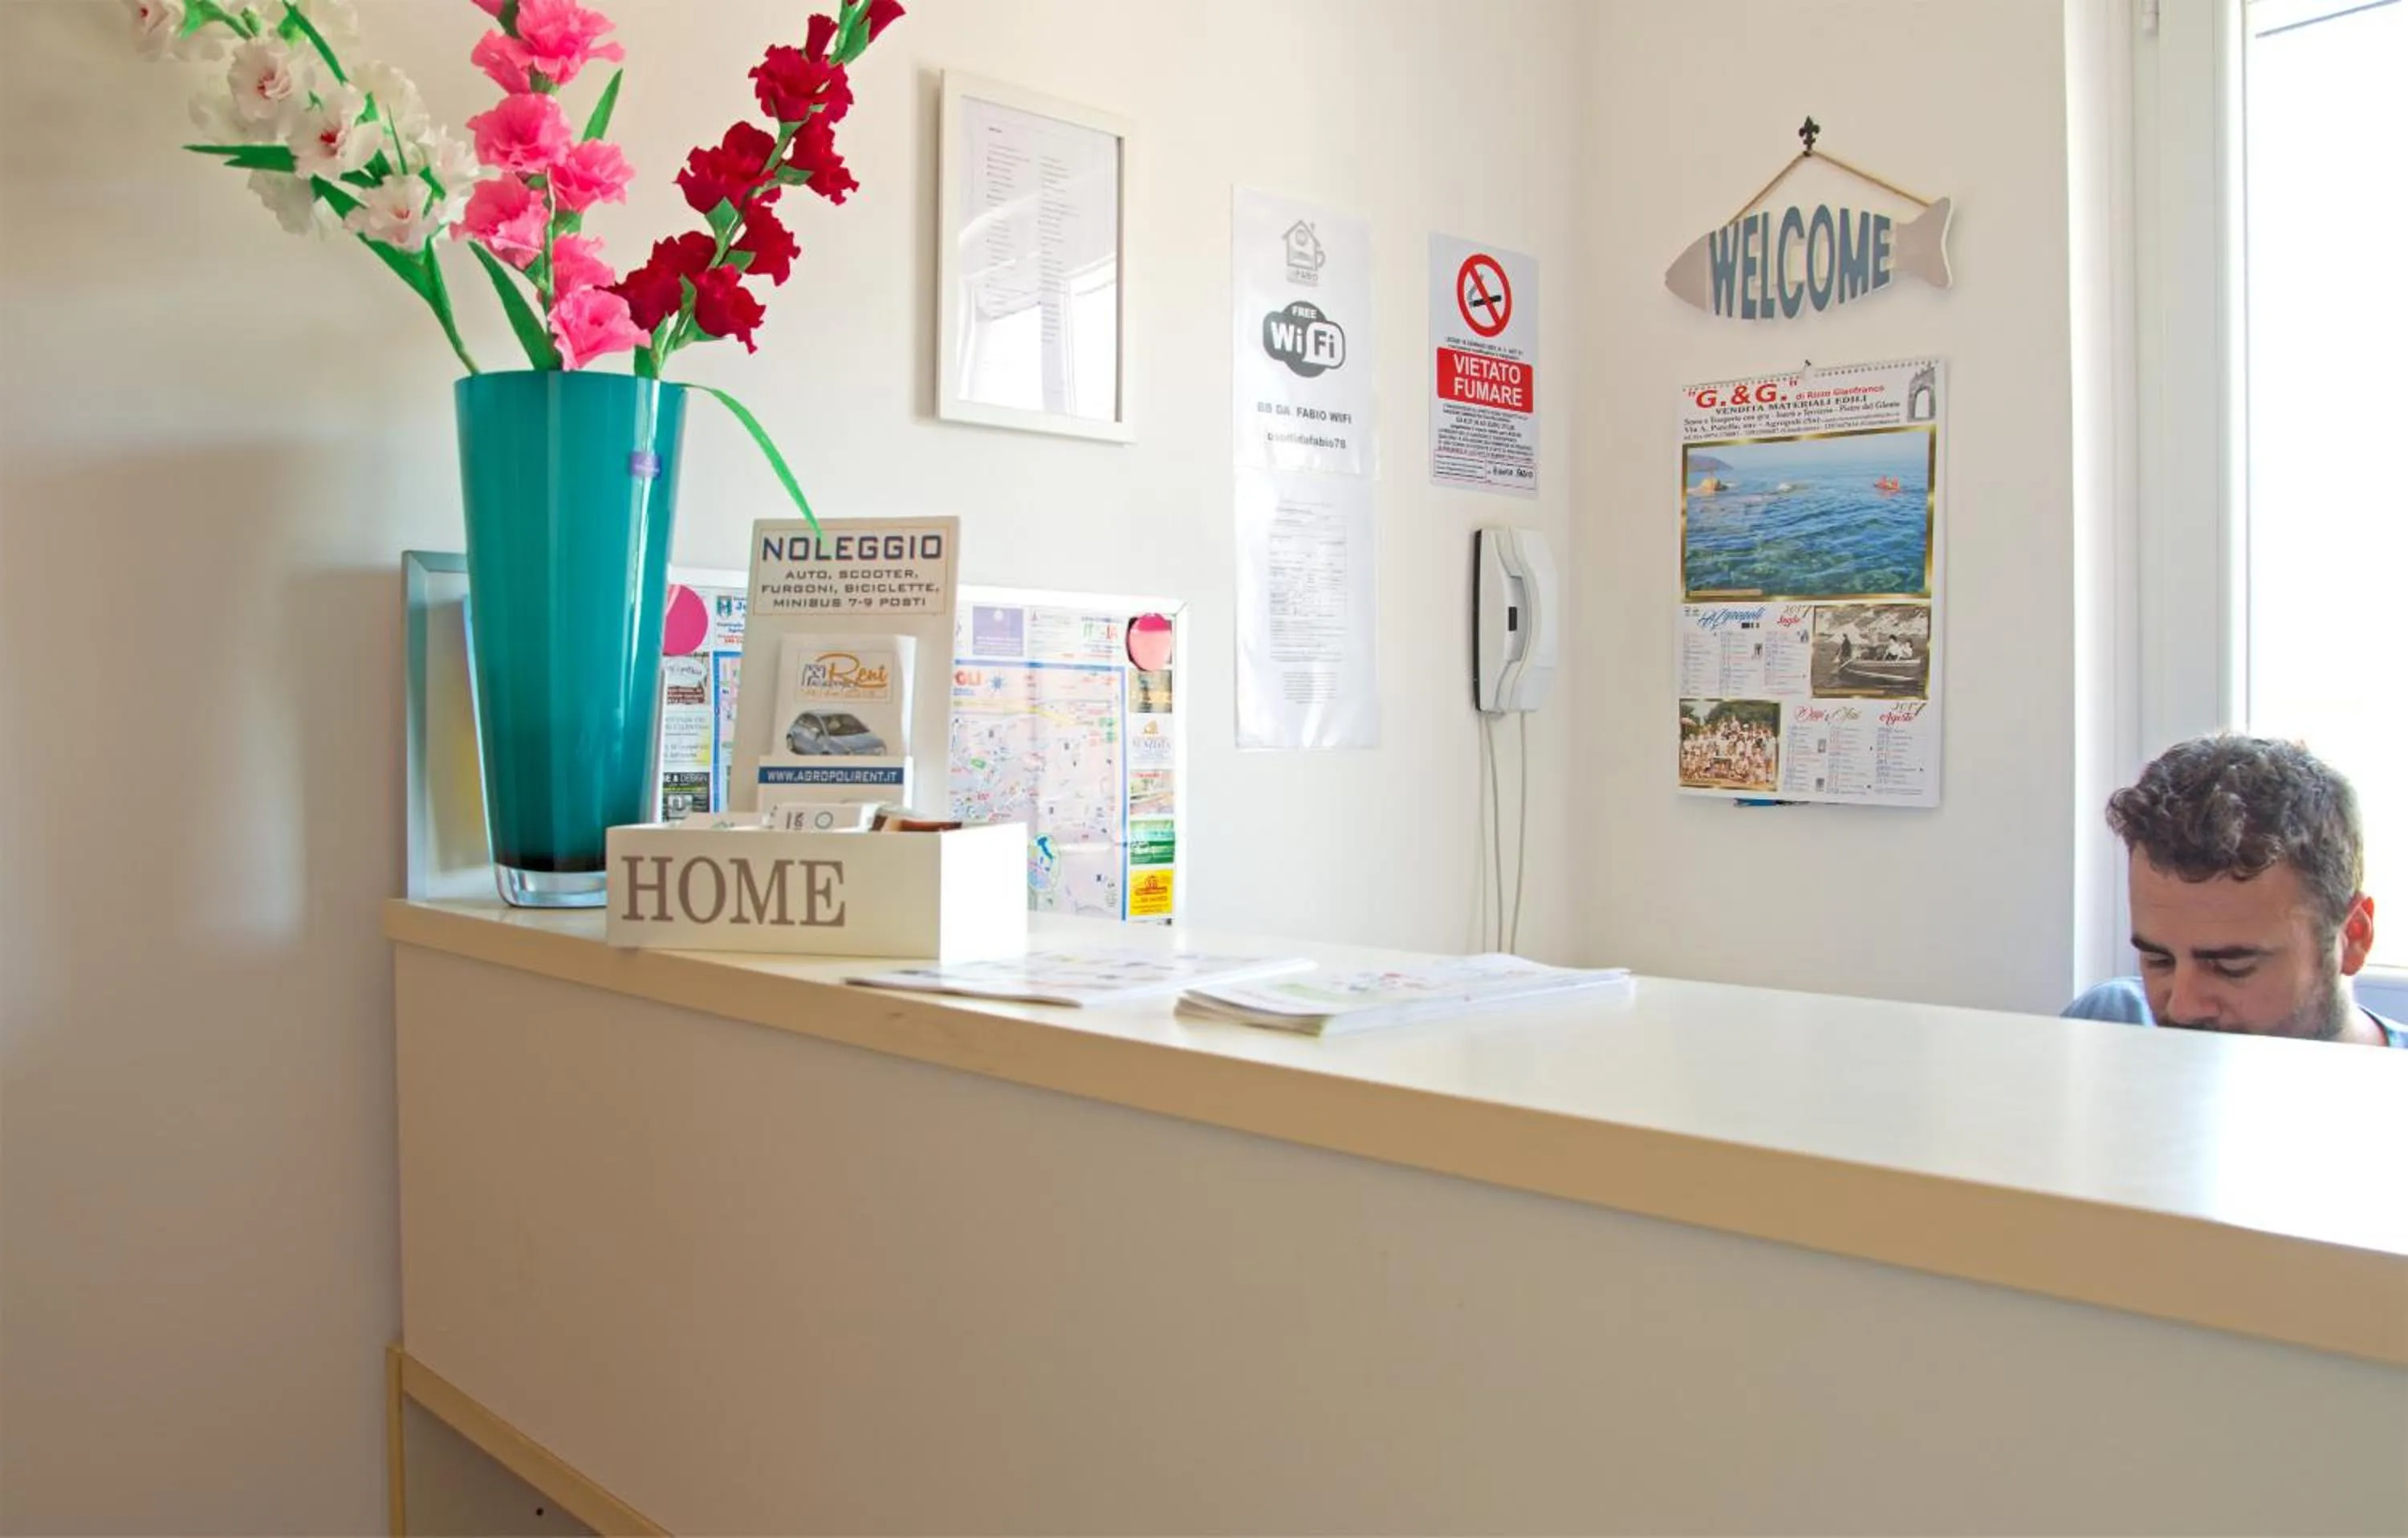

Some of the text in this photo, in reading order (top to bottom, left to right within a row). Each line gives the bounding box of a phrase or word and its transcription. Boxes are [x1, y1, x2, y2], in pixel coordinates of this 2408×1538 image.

[1709, 204, 1890, 320] WELCOME
[1291, 306, 1317, 319] FREE
[1454, 353, 1521, 384] VIETATO
[1454, 376, 1523, 407] FUMARE
[1296, 406, 1327, 421] FABIO
[1716, 395, 1866, 414] VENDITA MATERIALI EDILI
[763, 535, 942, 561] NOLEGGIO
[785, 569, 918, 580] AUTO, SCOOTER,
[761, 582, 940, 594] FURGONI, BICICLETTE,
[774, 597, 925, 608] MINIBUS 7-9 POSTI
[815, 653, 888, 688] Rent
[767, 770, 897, 783] WWW.AGROPOLIRENT.IT
[621, 855, 845, 927] HOME
